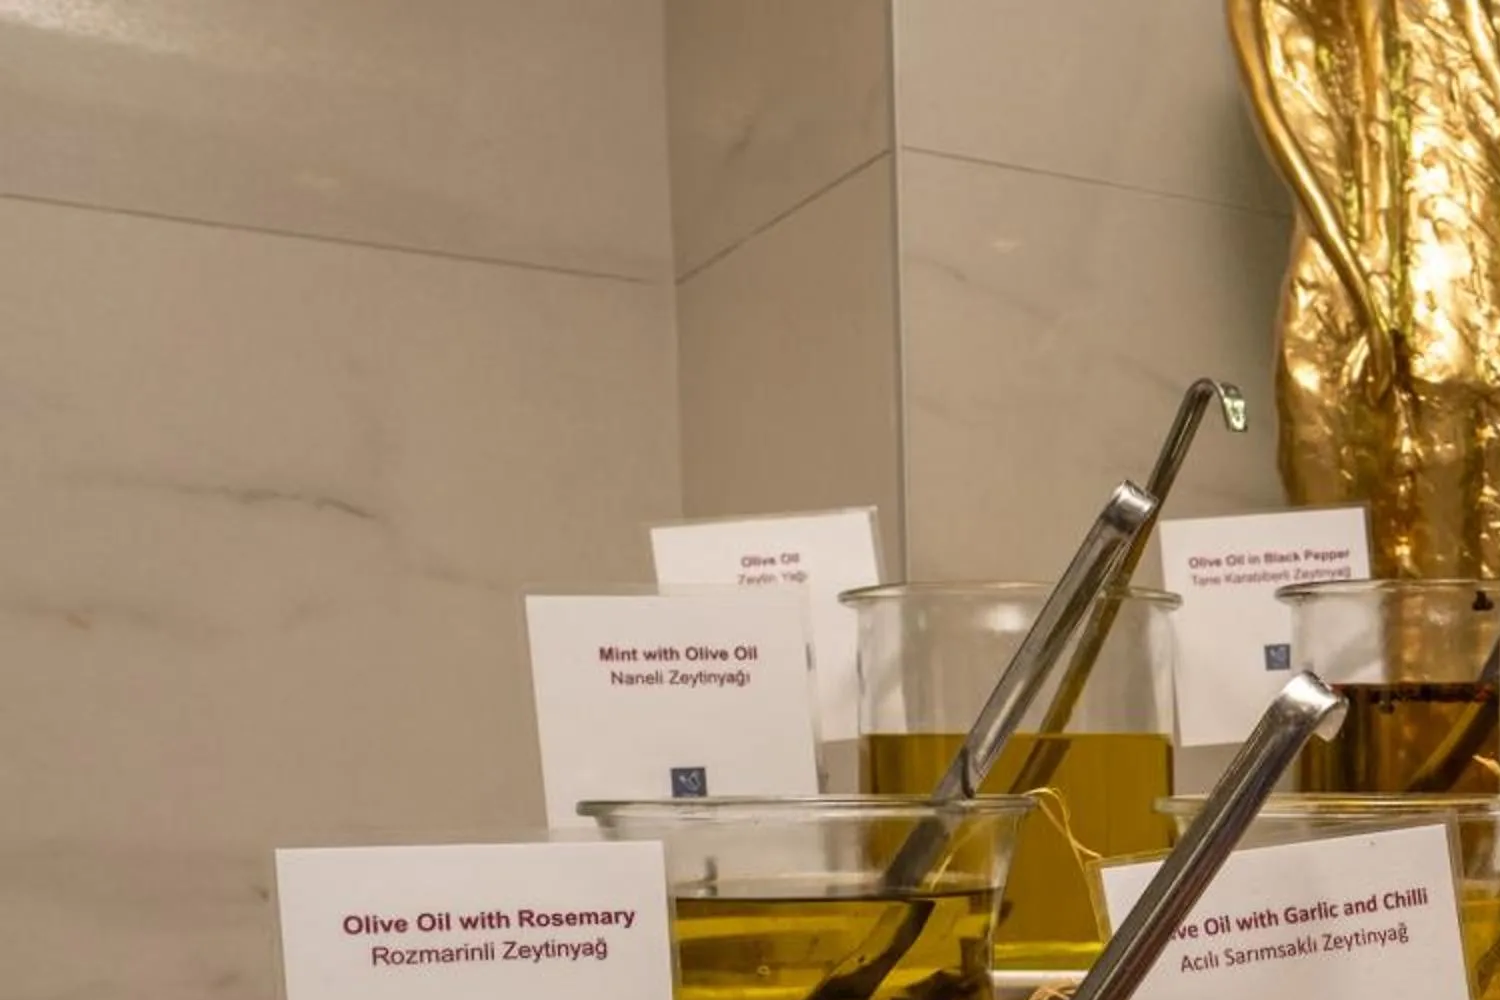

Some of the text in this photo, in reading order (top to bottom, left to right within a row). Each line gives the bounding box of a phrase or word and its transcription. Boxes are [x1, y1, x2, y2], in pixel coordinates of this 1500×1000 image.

[741, 552, 800, 568] Olive Oil
[1188, 548, 1350, 569] Olive Oil in Black Pepper
[599, 645, 758, 661] Mint with Olive Oil
[611, 671, 663, 685] Naneli
[343, 909, 636, 935] Olive Oil with Rosemary
[1203, 913, 1232, 937] Oil
[1236, 909, 1280, 932] with
[1283, 901, 1339, 924] Garlic
[1343, 894, 1379, 917] and
[1382, 887, 1429, 911] Chilli
[1322, 924, 1410, 952] Zeytinyağ
[371, 936, 608, 966] Rozmarinli Zeytinyağ
